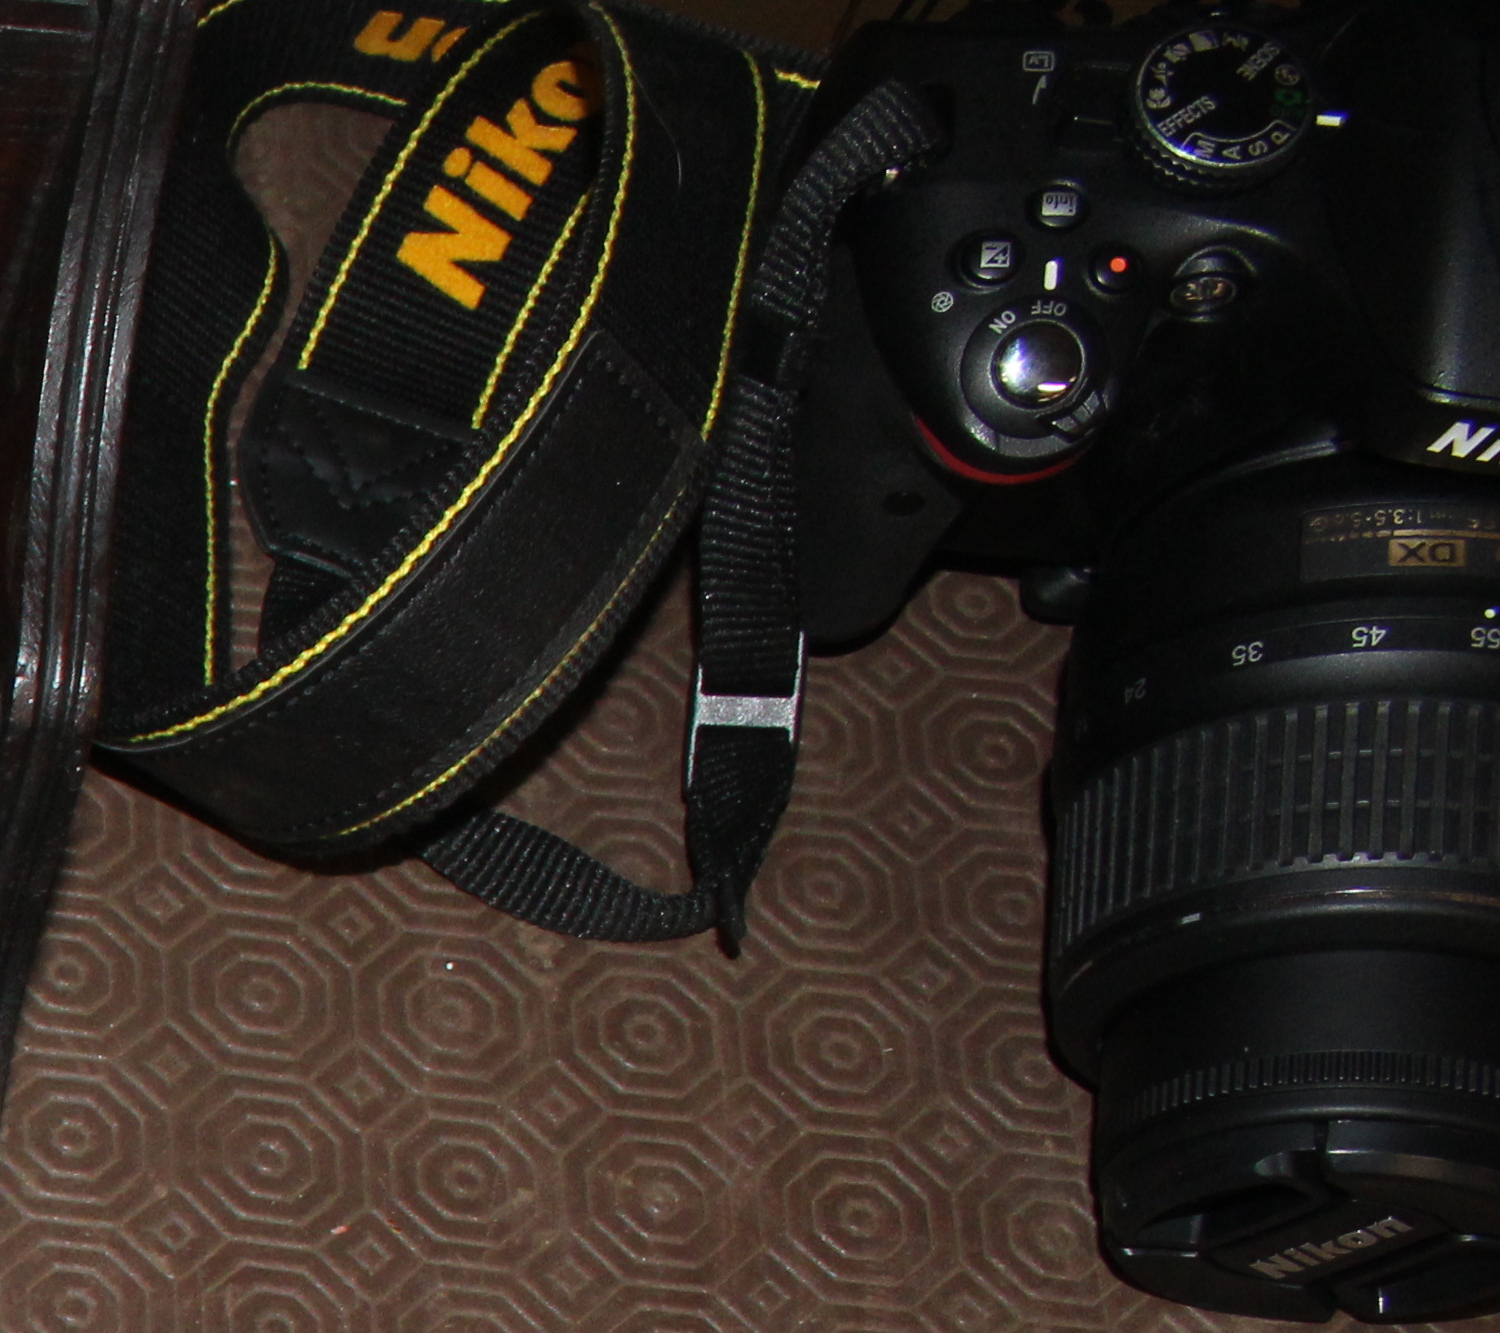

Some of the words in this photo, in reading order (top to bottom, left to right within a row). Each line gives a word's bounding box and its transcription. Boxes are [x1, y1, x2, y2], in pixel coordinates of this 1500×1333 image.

[1156, 95, 1218, 138] EFFECTS
[396, 44, 600, 311] Niko
[1030, 298, 1067, 317] OFF
[988, 309, 1017, 335] ON
[1397, 542, 1456, 563] DX
[1350, 625, 1387, 648] 45
[1231, 640, 1264, 668] 35
[1123, 677, 1148, 705] 24
[1248, 1215, 1414, 1280] Nikon
